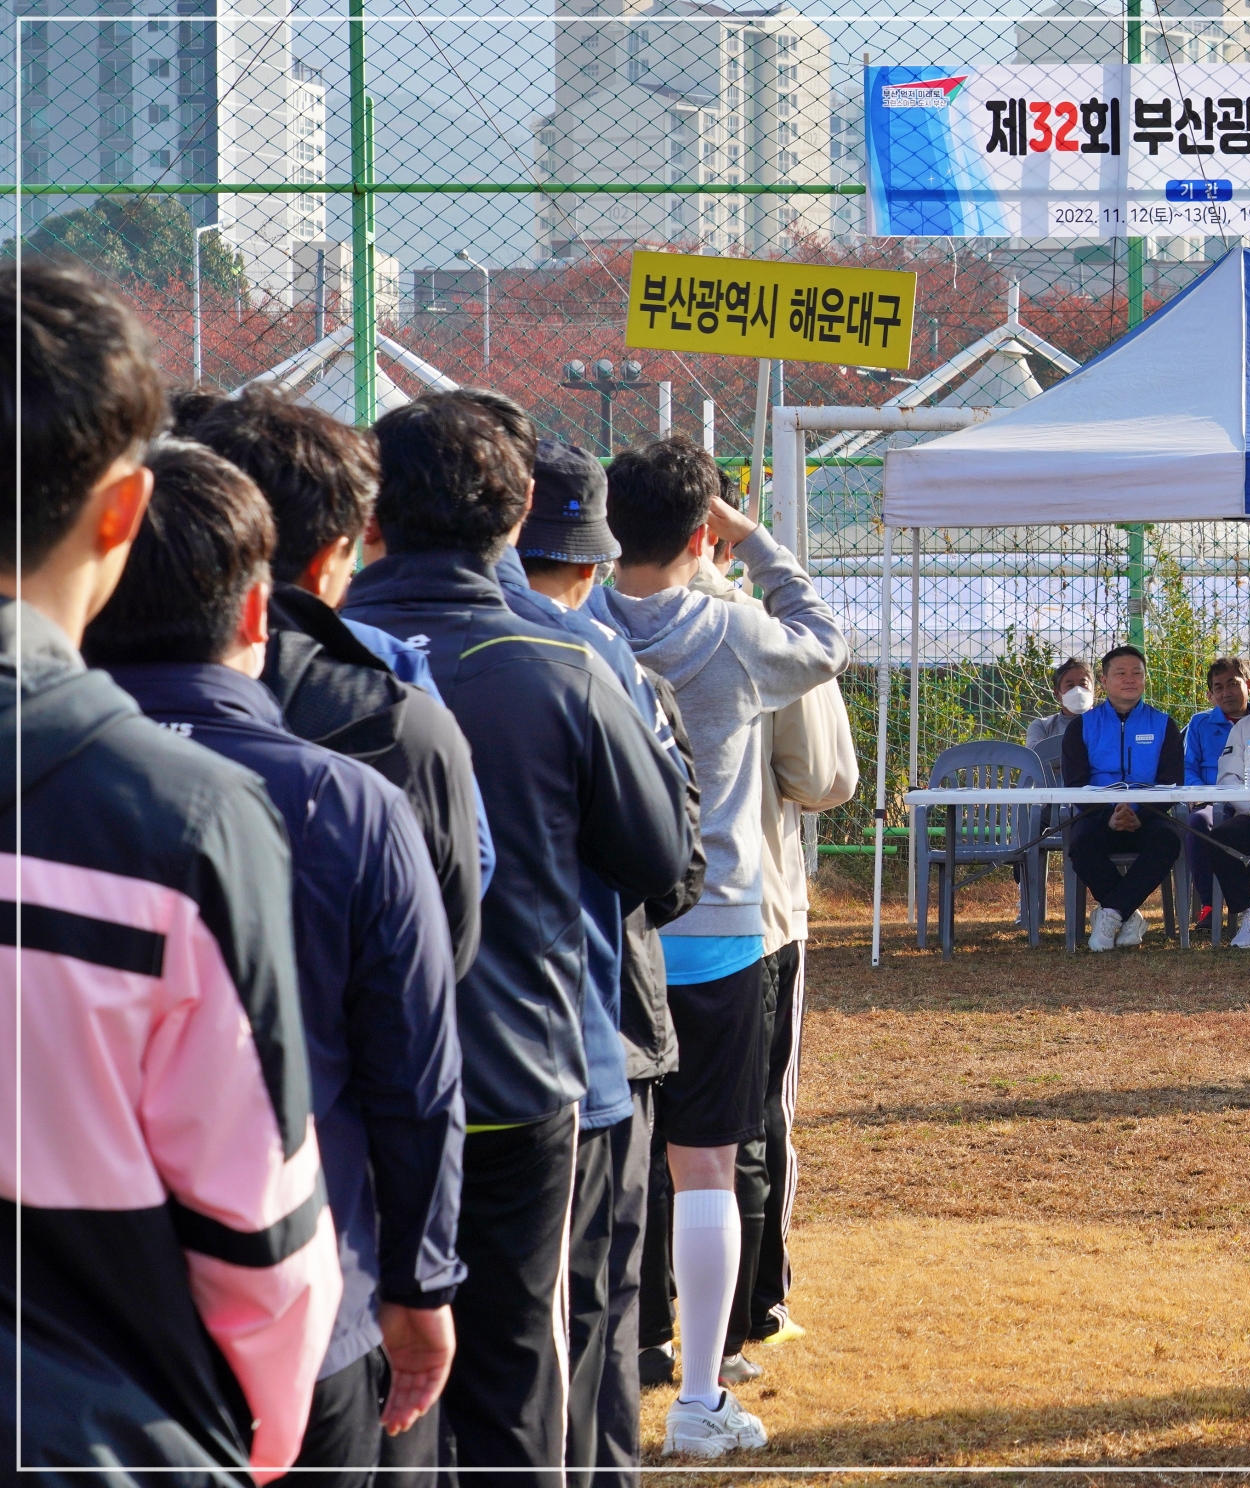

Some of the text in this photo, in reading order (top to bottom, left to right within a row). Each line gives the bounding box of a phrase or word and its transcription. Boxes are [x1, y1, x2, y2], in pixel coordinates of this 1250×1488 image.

[986, 96, 1121, 156] 제32회
[1055, 208, 1098, 224] 2022.
[1103, 208, 1125, 224] 11.
[639, 274, 902, 348] 부산광역시 해운대구
